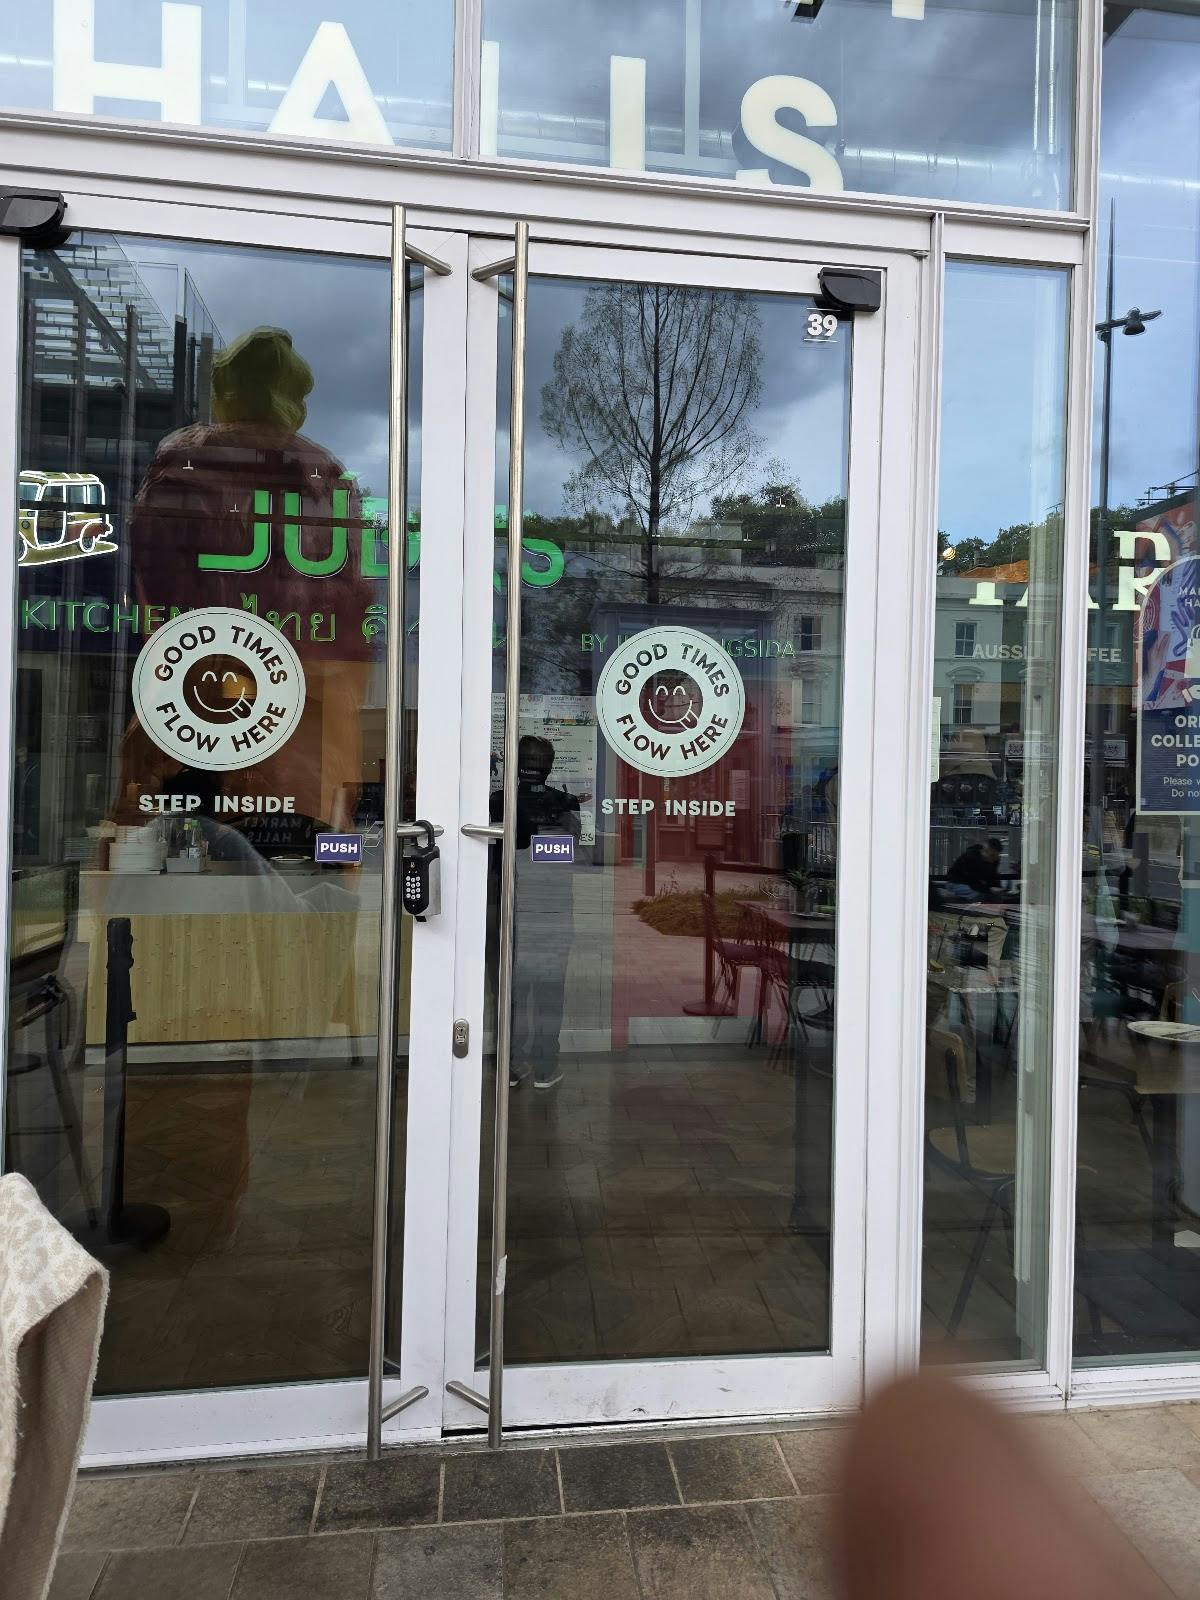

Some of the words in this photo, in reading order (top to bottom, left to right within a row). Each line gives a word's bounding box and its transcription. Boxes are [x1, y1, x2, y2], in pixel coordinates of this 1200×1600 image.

[807, 313, 838, 337] 39
[1178, 586, 1200, 597] MA
[581, 633, 609, 653] BY
[154, 625, 216, 682] GOOD
[231, 625, 288, 685] TIMES
[615, 643, 668, 696] GOOD
[681, 642, 730, 698] TIMES
[156, 701, 220, 753] FLOW
[230, 702, 287, 753] HERE
[1174, 715, 1200, 728] OR
[616, 713, 671, 761] FLOW
[680, 713, 729, 761] HERE
[1163, 776, 1193, 786] Please
[1171, 789, 1185, 798] Do
[138, 794, 202, 812] STEP
[214, 795, 296, 813] INSIDE
[601, 798, 655, 815] STEP
[664, 799, 736, 817] INSIDE
[320, 842, 358, 854] PUSH
[535, 843, 570, 854] PUSH
